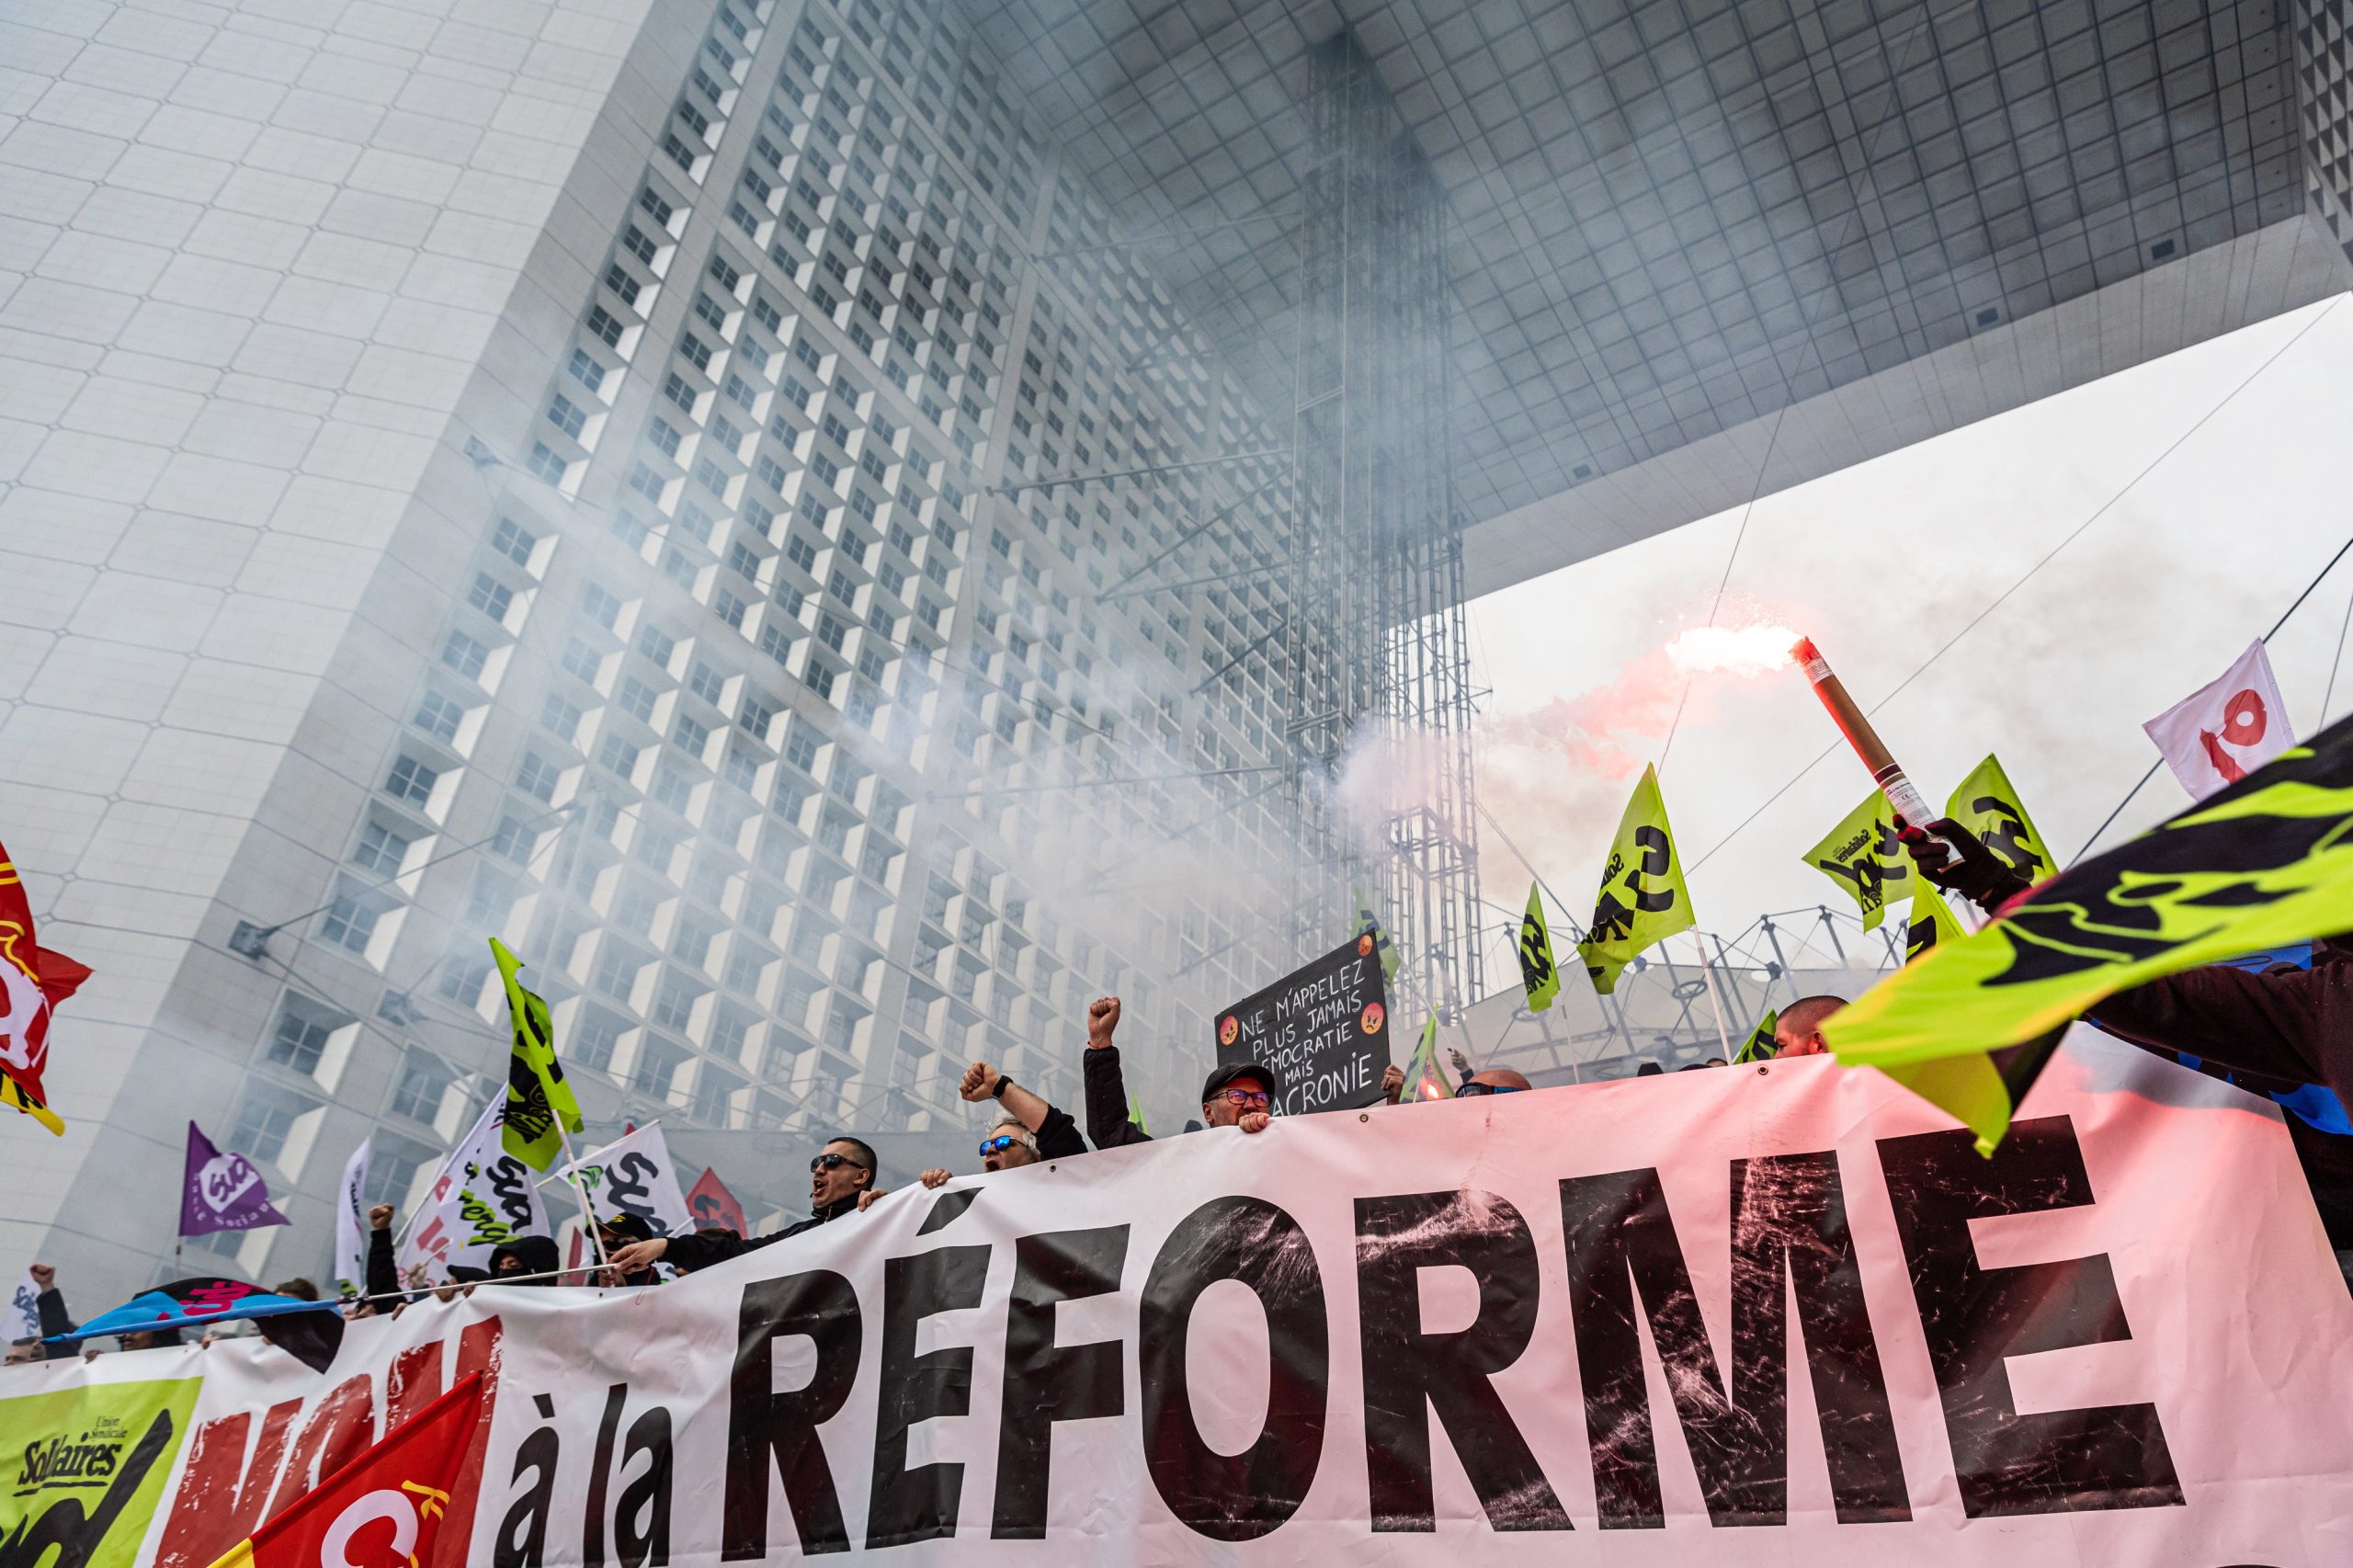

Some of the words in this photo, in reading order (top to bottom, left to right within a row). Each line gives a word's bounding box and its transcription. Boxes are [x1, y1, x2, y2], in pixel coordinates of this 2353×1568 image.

[1242, 1009, 1266, 1042] NE
[1277, 959, 1365, 1021] M'APPELEZ
[1253, 1023, 1296, 1061] PLUS
[1261, 1021, 1353, 1074] EMOCRATIE
[1272, 1052, 1372, 1118] ACRONIE
[494, 1392, 560, 1568] à
[582, 1382, 674, 1568] la
[721, 1114, 2187, 1562] RÉFORME
